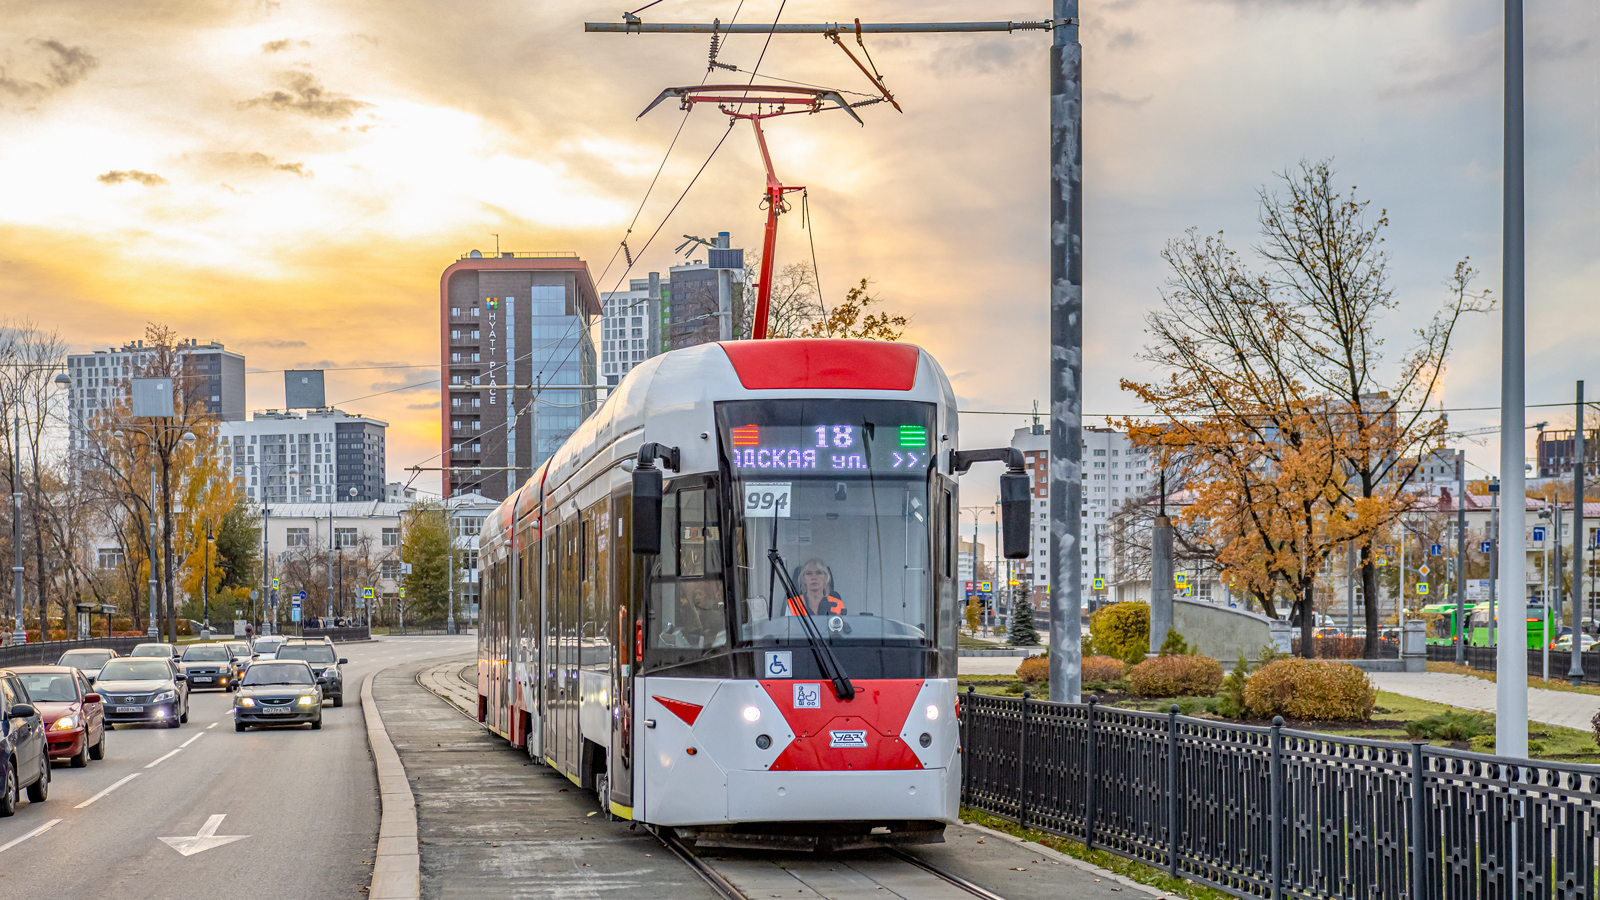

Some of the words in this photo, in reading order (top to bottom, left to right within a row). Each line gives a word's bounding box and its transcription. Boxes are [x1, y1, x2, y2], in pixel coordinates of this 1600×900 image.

[489, 312, 497, 356] HYATT
[489, 361, 497, 405] PLACE
[815, 424, 853, 448] 18
[831, 454, 868, 469] ул.
[747, 492, 788, 510] 994
